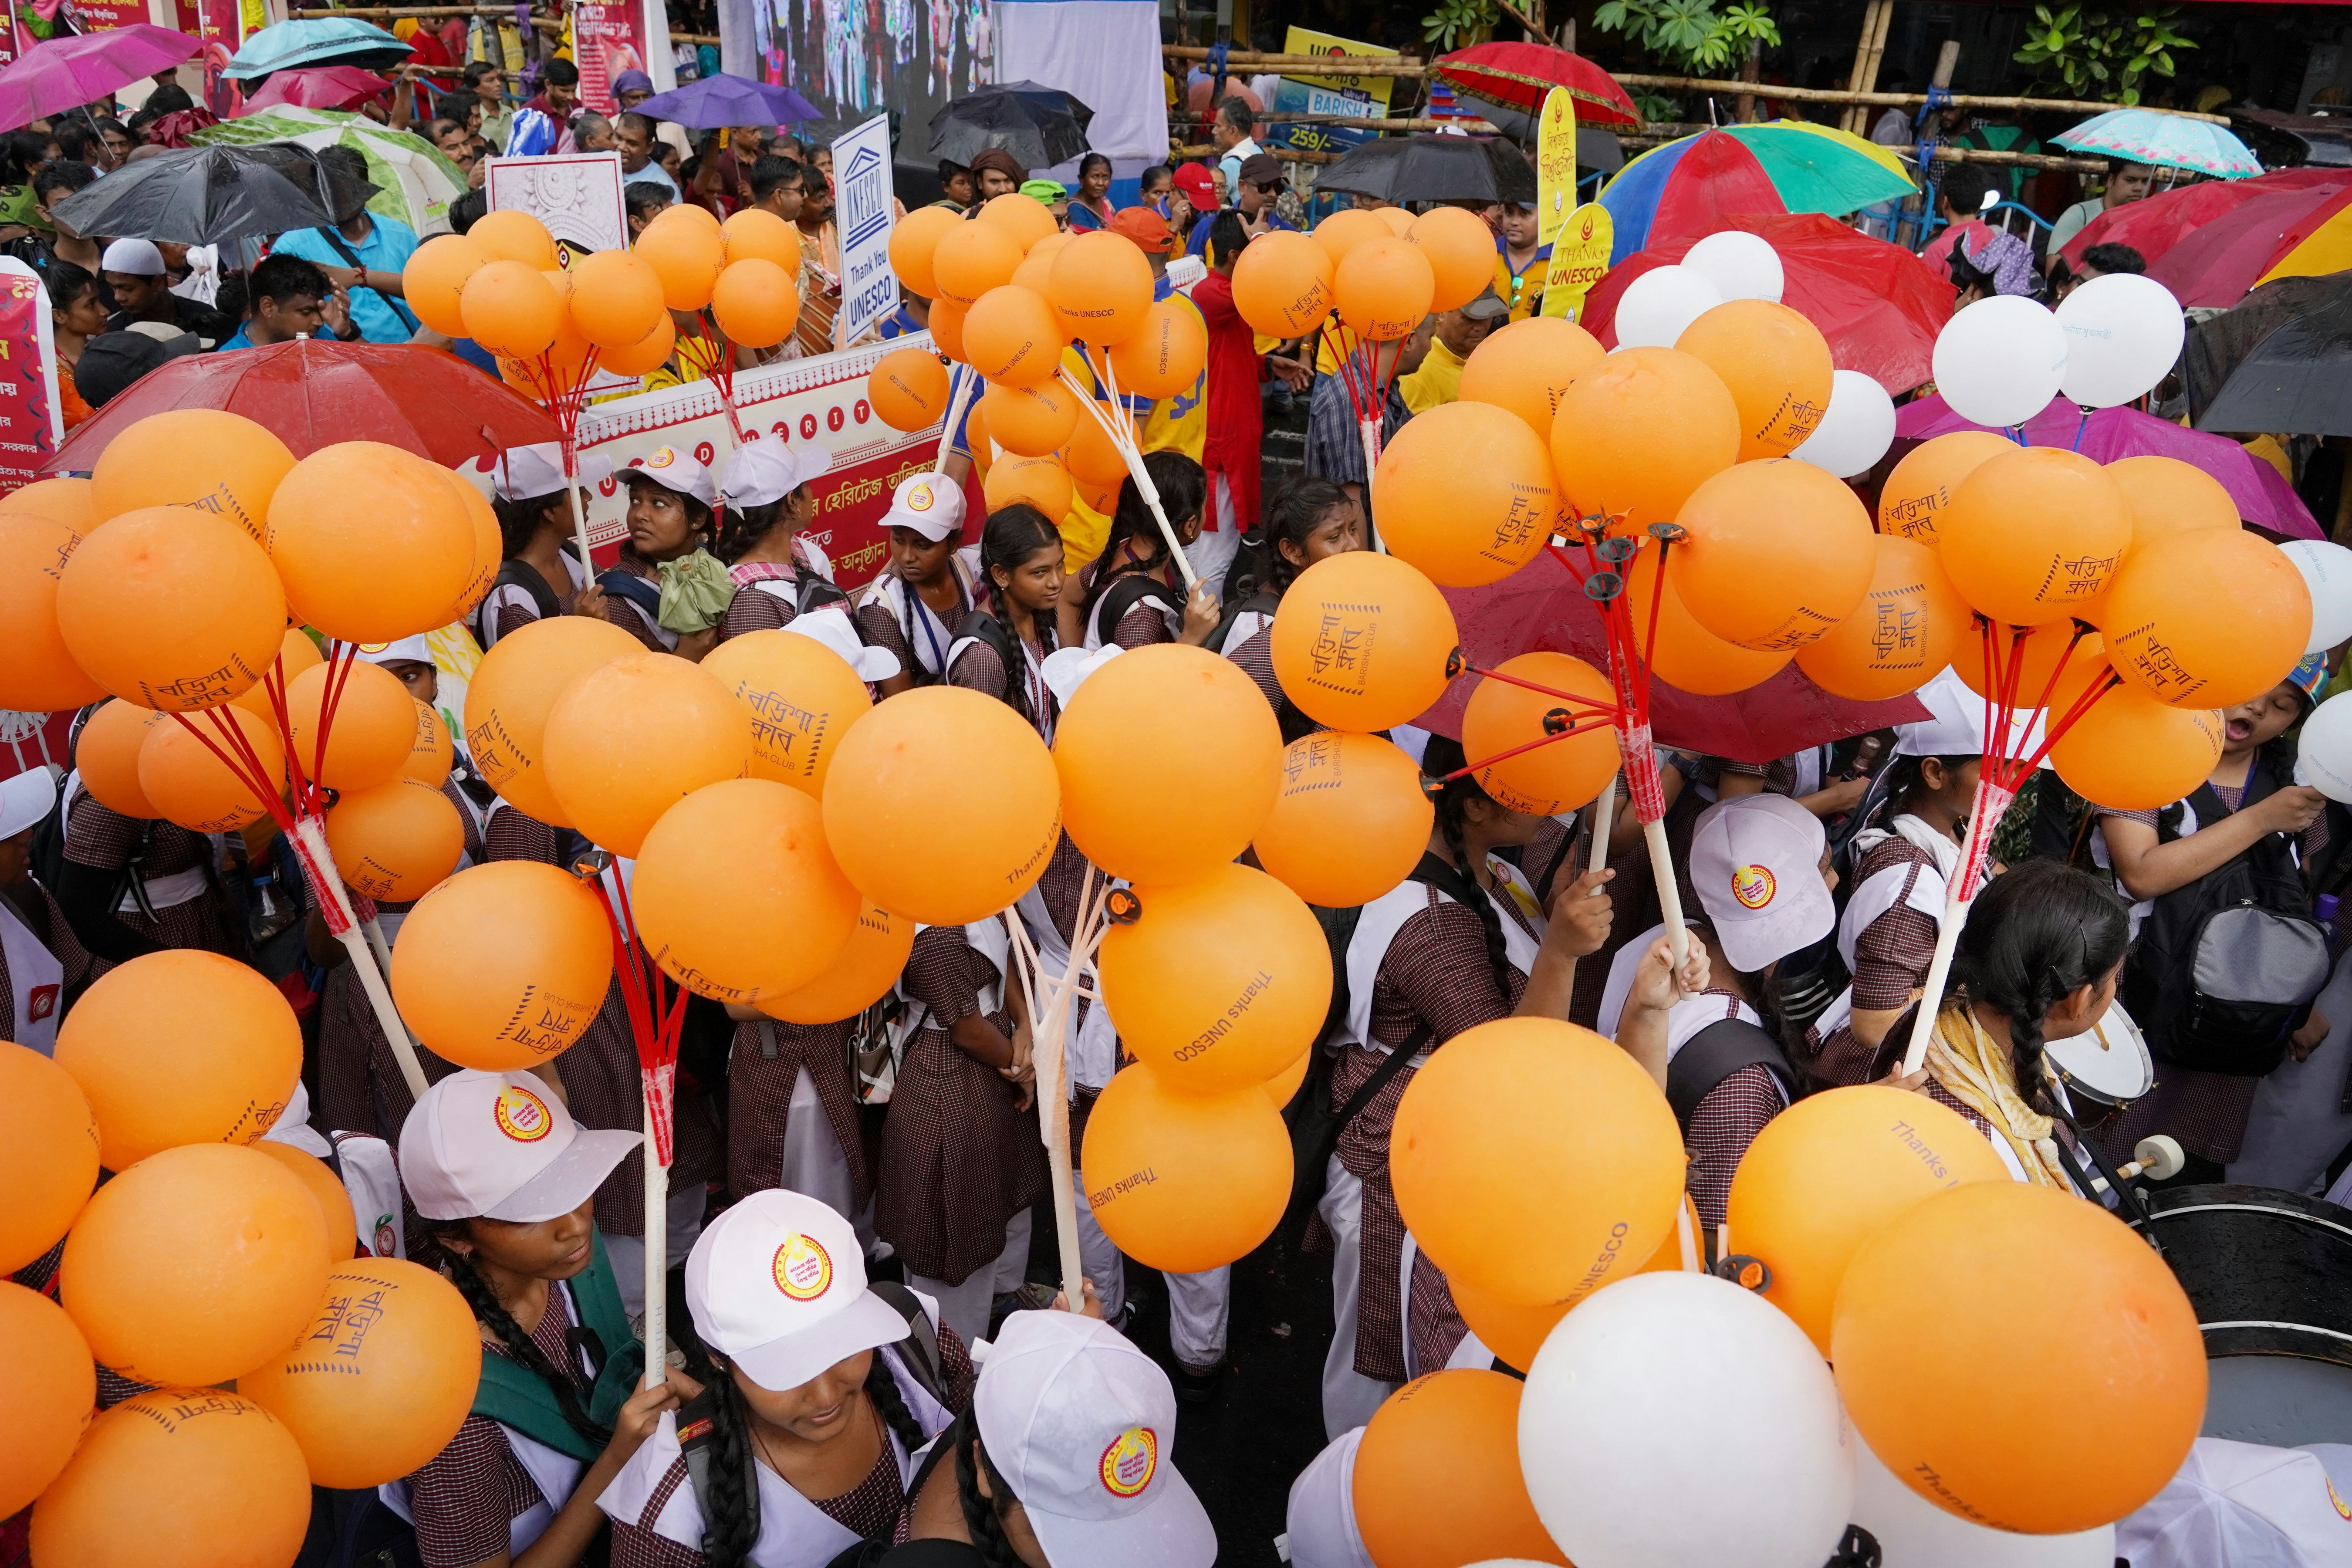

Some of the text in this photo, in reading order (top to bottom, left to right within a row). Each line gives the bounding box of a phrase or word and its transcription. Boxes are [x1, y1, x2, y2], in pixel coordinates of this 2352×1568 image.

[579, 6, 605, 20] WRLD
[1314, 93, 1362, 117] BARISH
[1288, 127, 1331, 152] 259/-
[847, 169, 882, 229] UNESCO
[851, 250, 886, 286] Thank You
[1560, 247, 1605, 262] THANKS
[1551, 267, 1604, 286] UNESCO
[850, 275, 891, 327] UNESCO
[953, 295, 977, 304] UNESC
[1058, 305, 1114, 318] Thanks UNESCO
[1290, 284, 1321, 311] বড়িশা
[992, 341, 1032, 378] Thanks UNESCO
[1159, 341, 1169, 375] UNESCO
[889, 375, 928, 409] Thanks UNESCO
[1037, 393, 1058, 412] Thanks
[0, 442, 37, 453] সরকার
[1764, 437, 1788, 449] BARISHA
[1012, 459, 1060, 470] Thanks UNESCO
[825, 477, 883, 513] হেরিটেজ
[1890, 494, 1938, 521] বড়িশা
[1490, 494, 1529, 549] বড়িশা
[841, 540, 887, 572] অনুষ্ঠান
[1519, 527, 1541, 558] BARISHA
[2064, 555, 2115, 579] বড়িশা
[1311, 613, 1343, 674] বড়িশা
[1872, 602, 1897, 660] বড়িশা
[1919, 622, 1928, 658] BARISHA
[1358, 622, 1377, 686] BARISHA CLUB
[2148, 634, 2194, 687] বড়িশা
[2298, 663, 2311, 673] DIA
[155, 665, 235, 696] বড়িশা
[2119, 649, 2162, 696] BARISHA CLUB
[748, 689, 815, 735] বড়িশা
[500, 767, 518, 781] CLUB
[770, 754, 796, 771] CLUB
[1333, 747, 1342, 776] BARISHA
[1497, 778, 1515, 794] CLUB
[1517, 791, 1549, 804] BARISHA
[1005, 841, 1048, 884] Thanks
[543, 992, 591, 1013] BARISHA CLUB
[1173, 970, 1272, 1062] Thanks UNESCO
[1891, 1120, 1947, 1179] Thanks
[1115, 1167, 1158, 1194] Thanks
[1574, 1222, 1629, 1291] UNESCO
[333, 1291, 385, 1360] বড়িশা
[1914, 1462, 1986, 1521] Thanks
